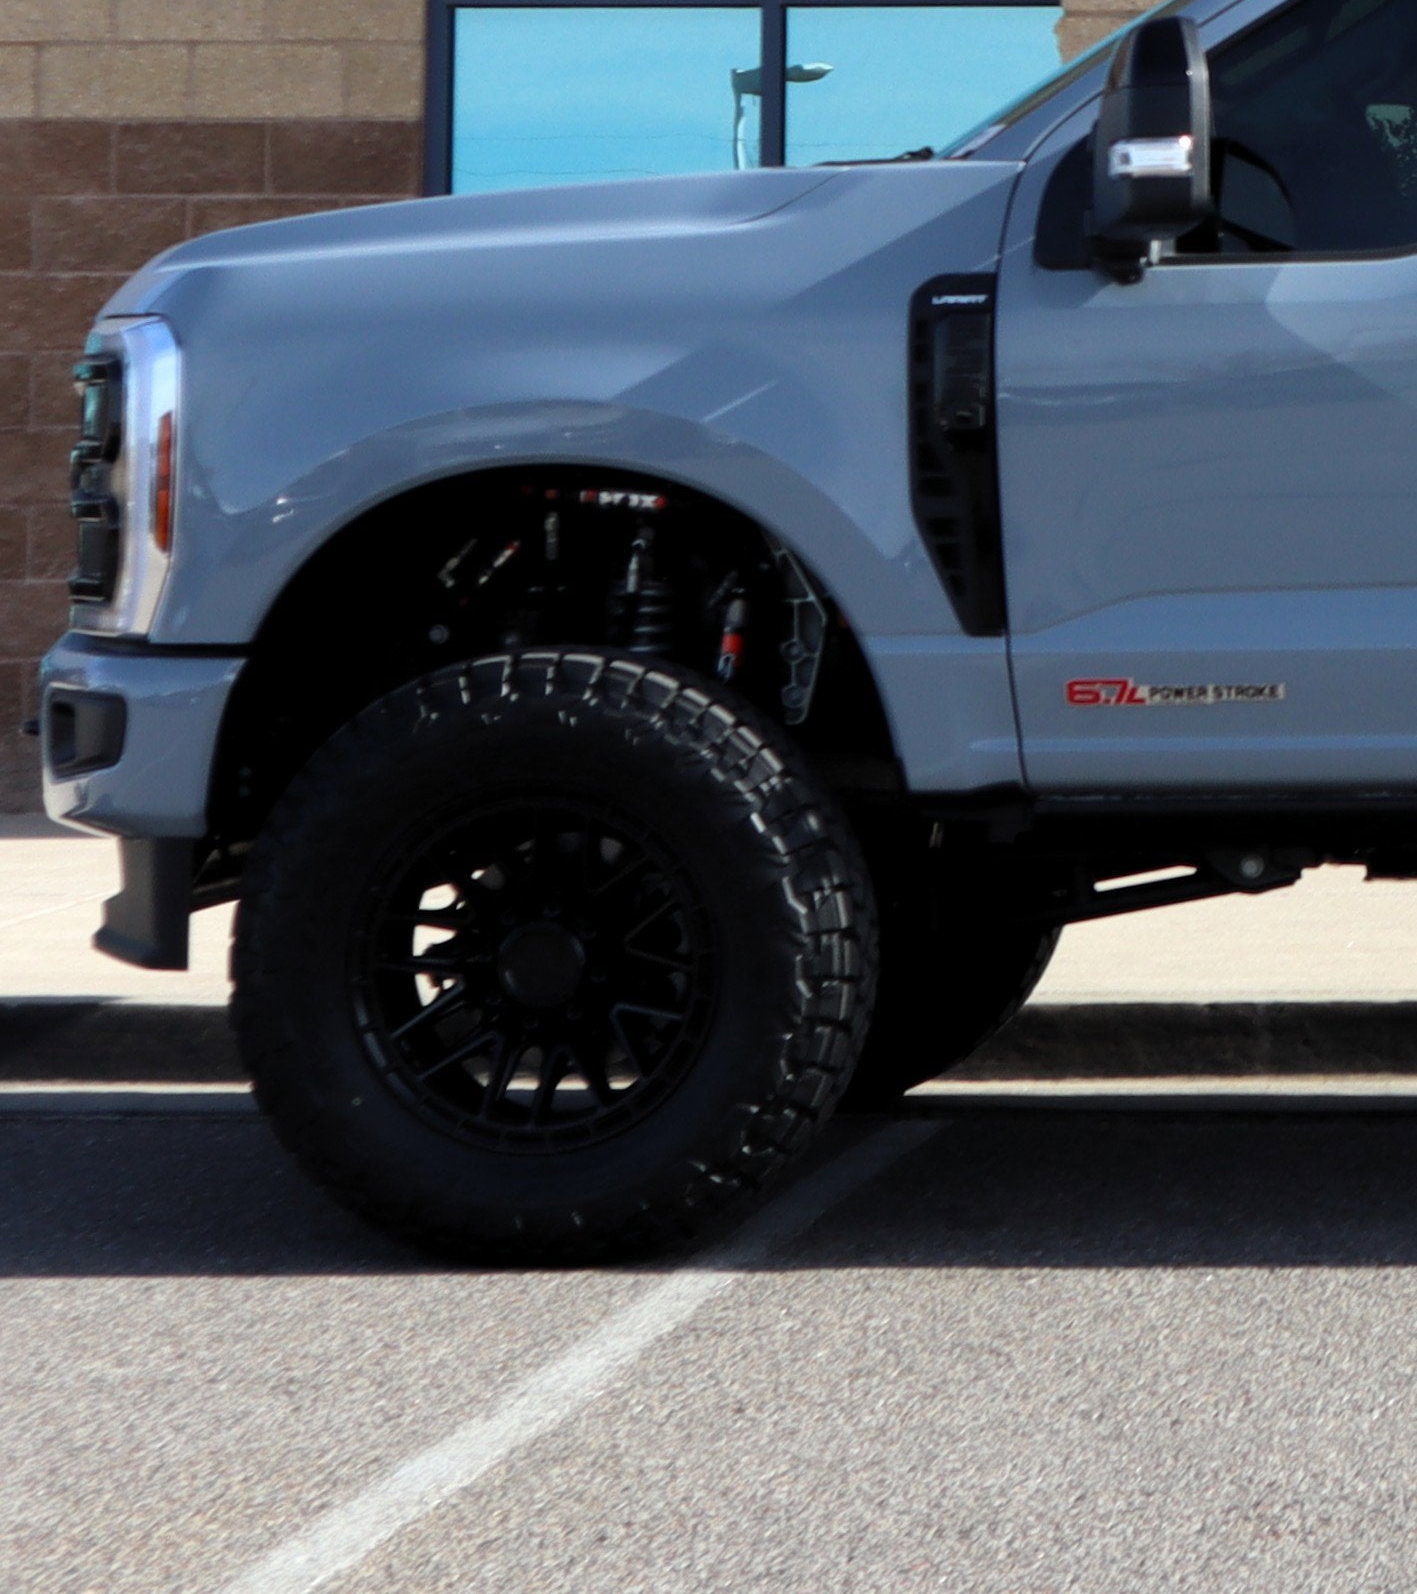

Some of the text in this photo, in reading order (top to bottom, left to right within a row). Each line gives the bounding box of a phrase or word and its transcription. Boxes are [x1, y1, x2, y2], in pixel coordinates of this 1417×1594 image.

[1065, 679, 1280, 705] 6.7L POWER STROKE
